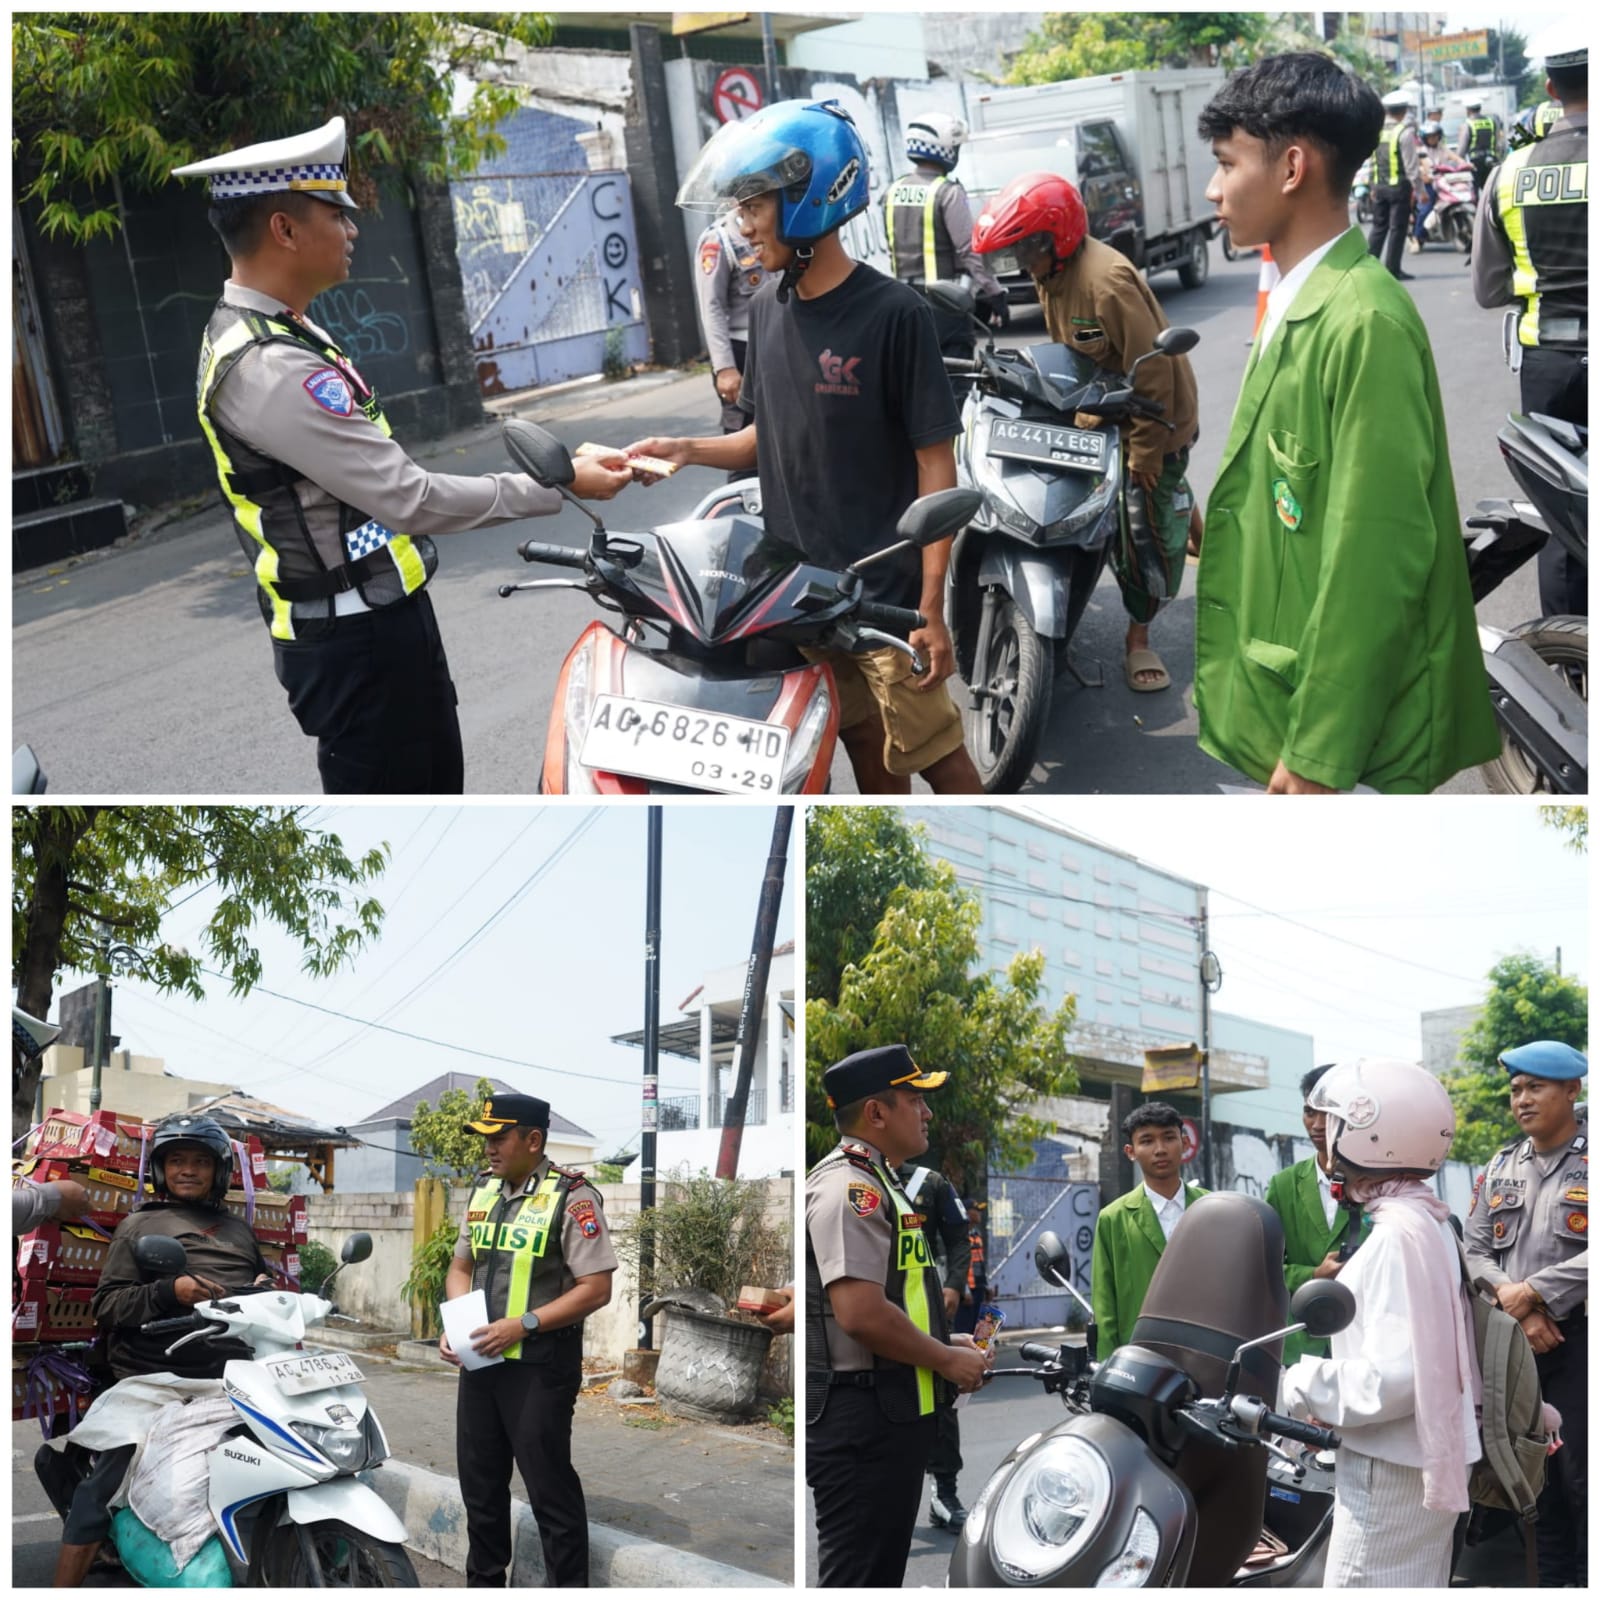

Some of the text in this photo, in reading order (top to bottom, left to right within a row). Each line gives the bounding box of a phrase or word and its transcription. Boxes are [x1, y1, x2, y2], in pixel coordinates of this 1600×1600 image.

[1021, 427, 1064, 447] 4414
[1068, 435, 1099, 452] ECS
[699, 569, 746, 585] HONDA
[651, 710, 730, 746] 6826
[745, 727, 782, 758] HD
[518, 1214, 546, 1226] POLRI
[300, 1357, 332, 1375] 4786
[224, 1448, 261, 1466] SUZUKI
